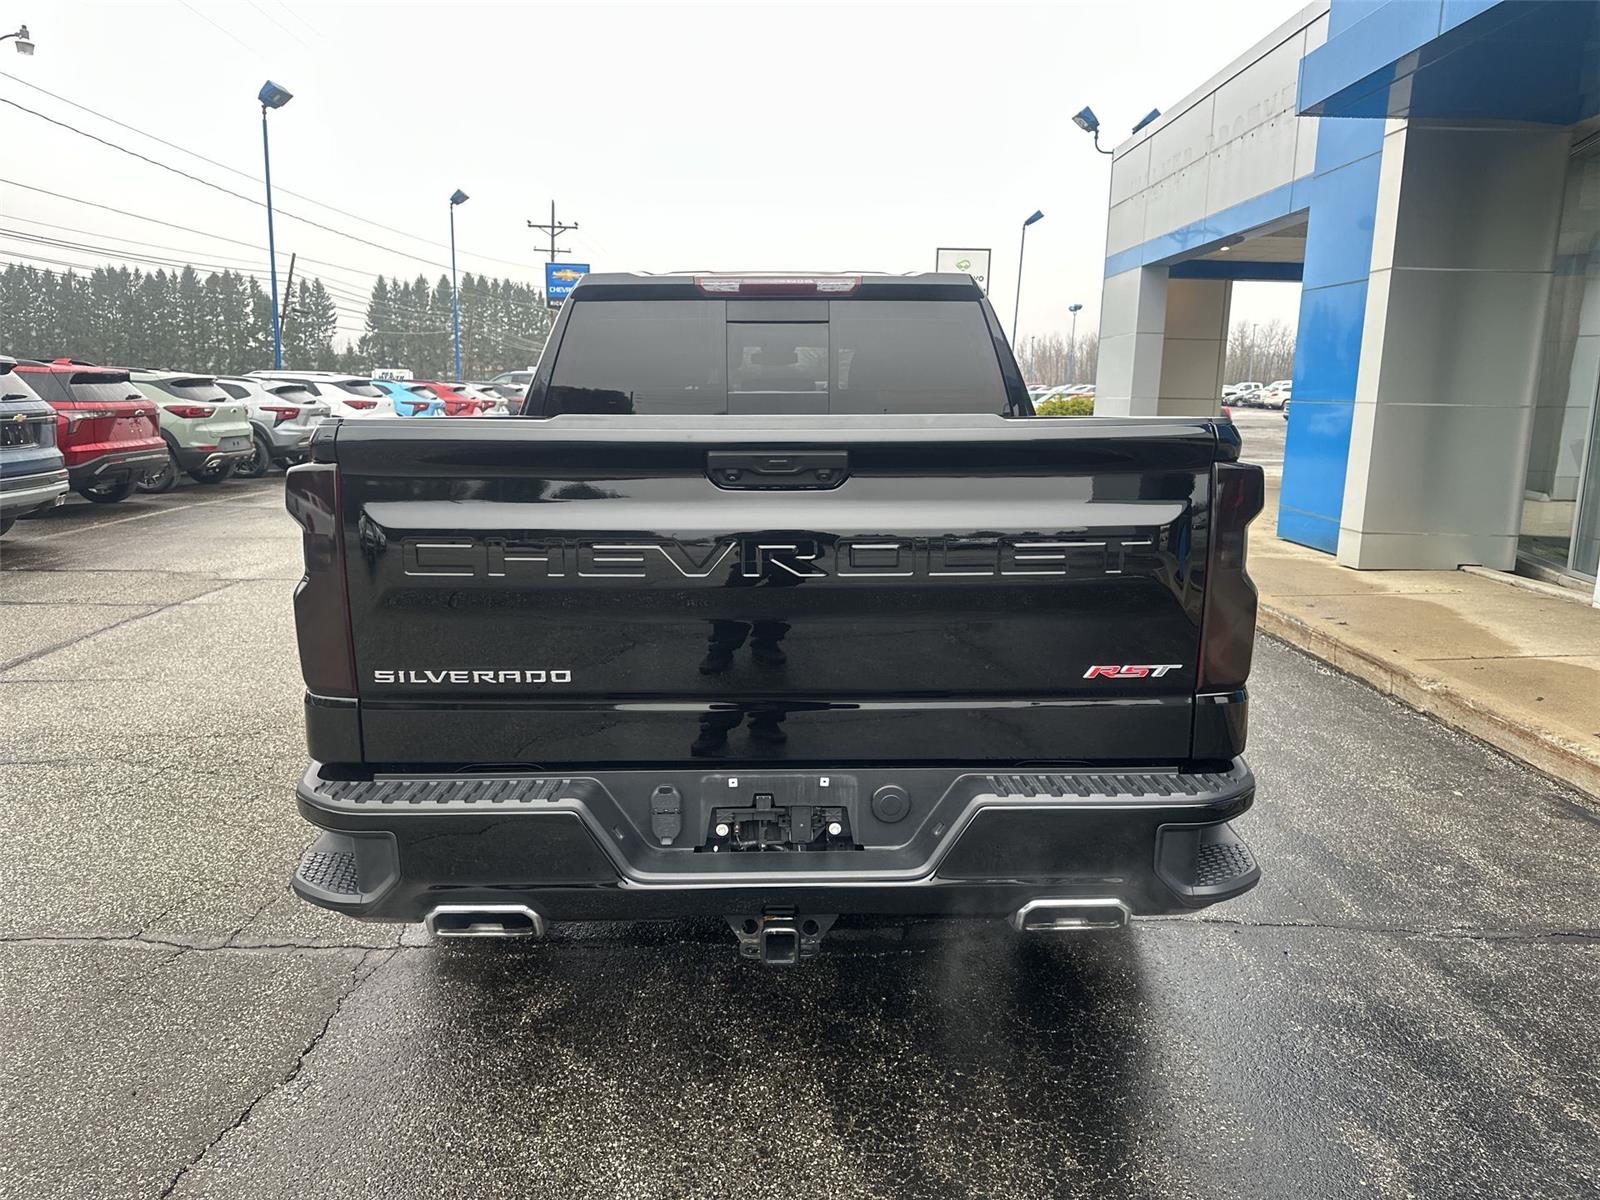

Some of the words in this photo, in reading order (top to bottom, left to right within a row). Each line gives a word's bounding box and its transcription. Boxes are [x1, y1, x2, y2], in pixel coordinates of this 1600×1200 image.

[402, 536, 1153, 576] CHEVROLET
[374, 670, 572, 683] SILVERADO
[1083, 664, 1183, 679] RST
